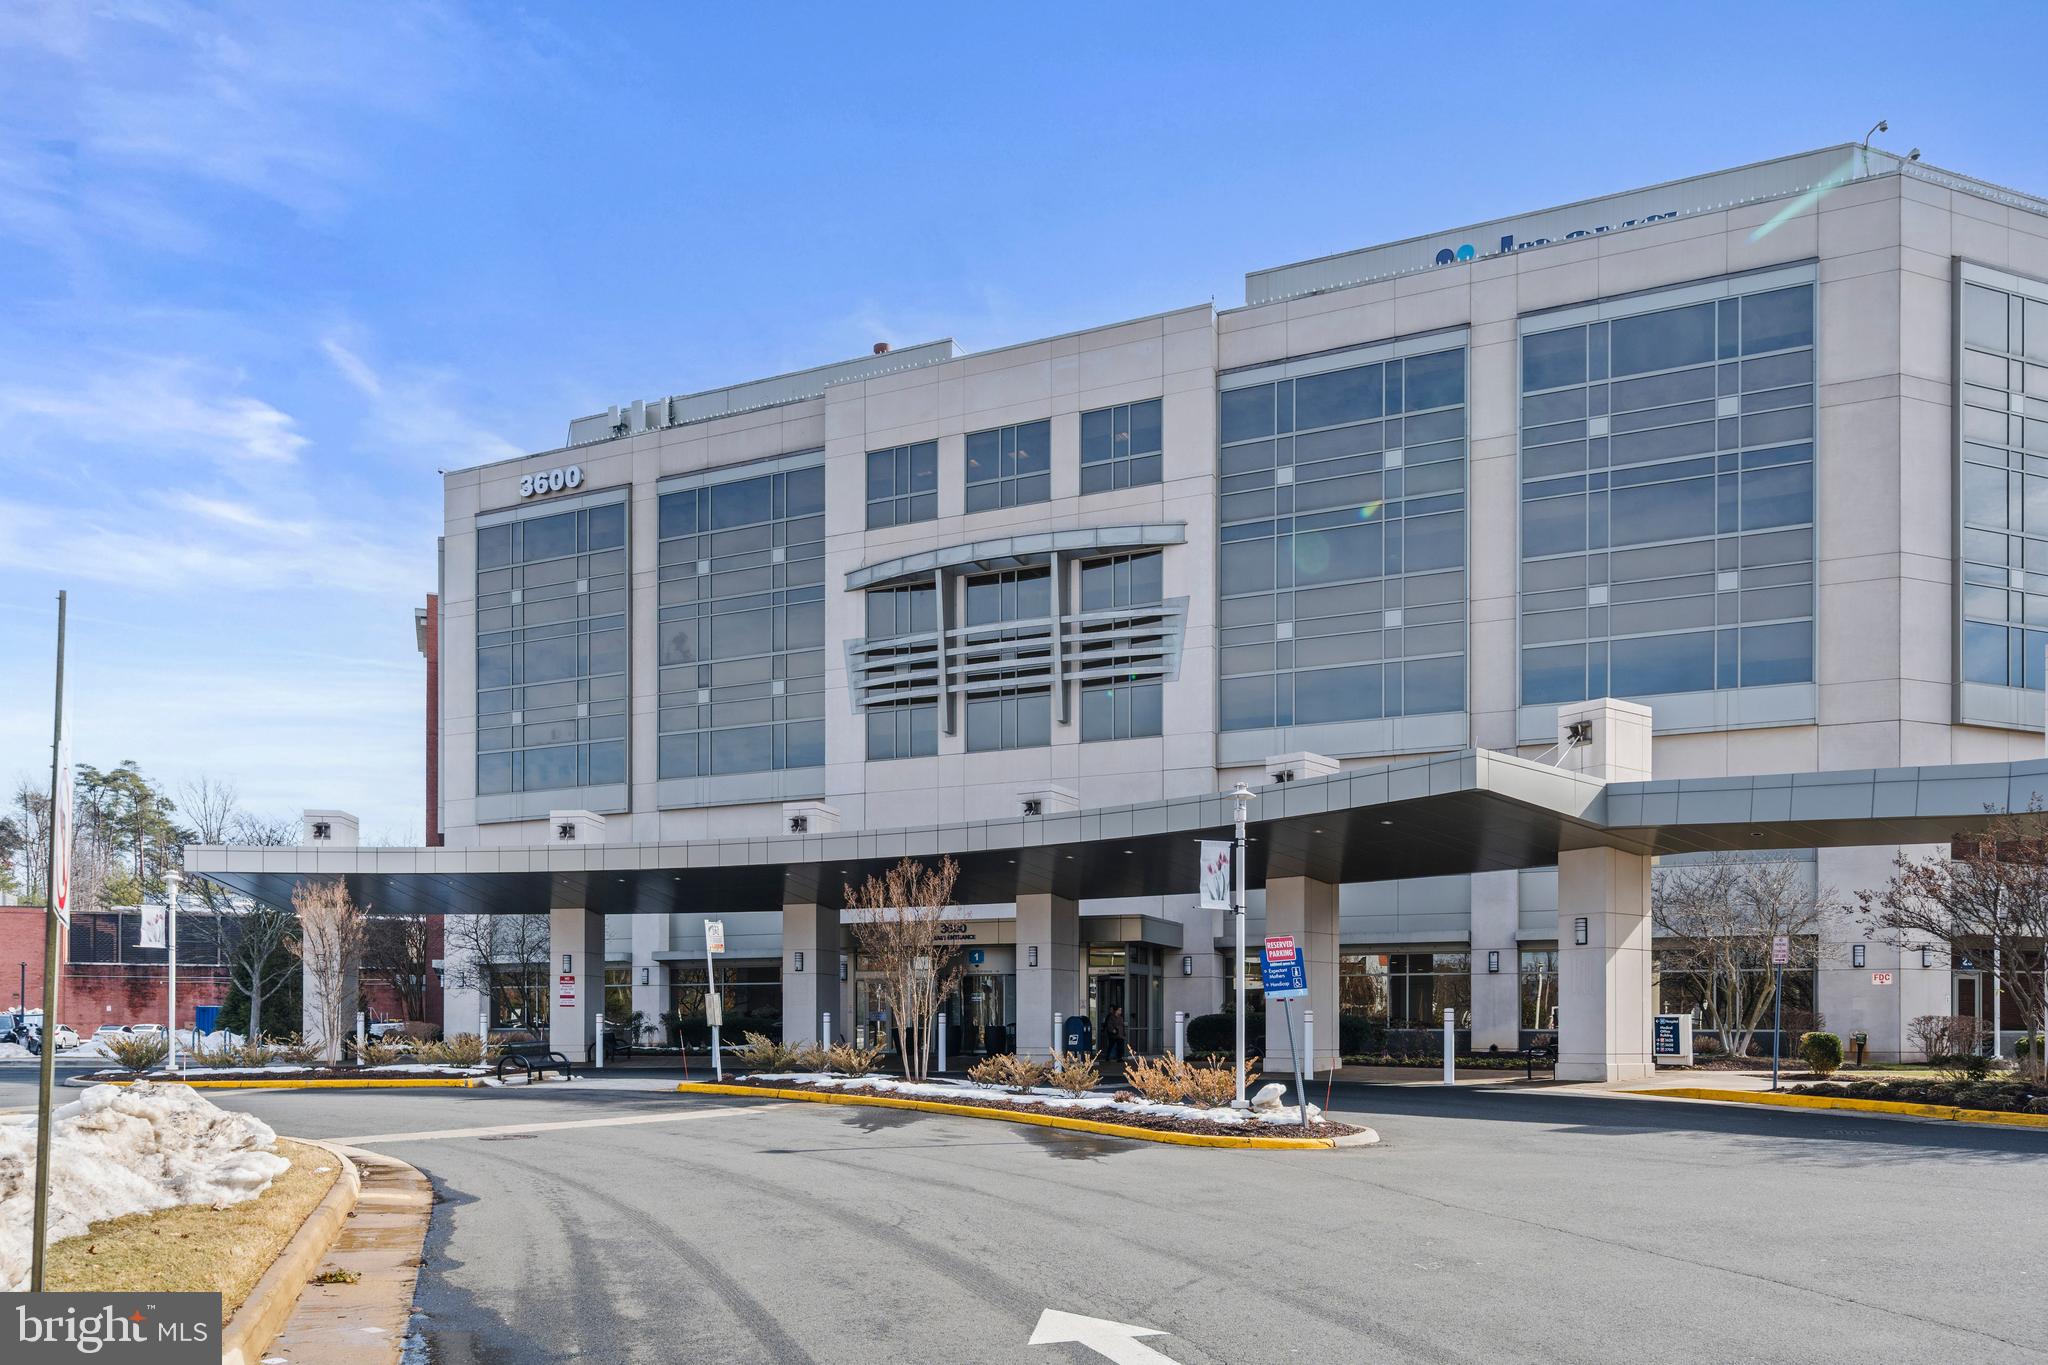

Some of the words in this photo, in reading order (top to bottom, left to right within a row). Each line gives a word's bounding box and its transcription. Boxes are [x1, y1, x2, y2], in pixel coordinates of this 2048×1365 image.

[520, 465, 582, 497] 3600
[1267, 940, 1292, 948] RESERVED
[974, 952, 979, 961] 1
[1268, 950, 1293, 958] PARKING
[1873, 973, 1890, 981] FDC
